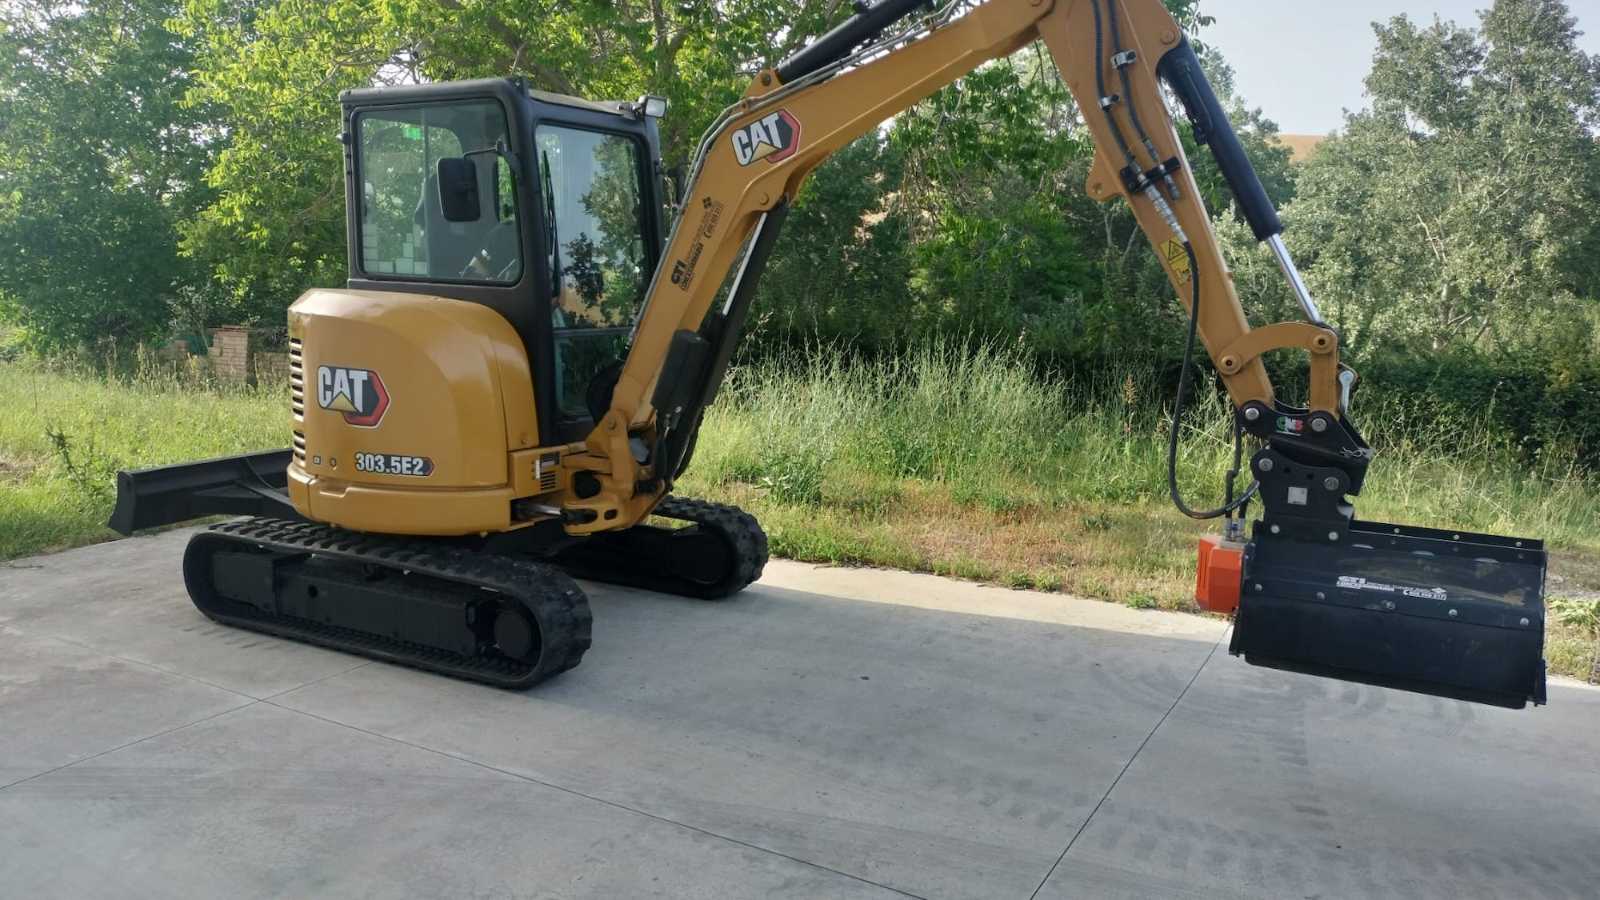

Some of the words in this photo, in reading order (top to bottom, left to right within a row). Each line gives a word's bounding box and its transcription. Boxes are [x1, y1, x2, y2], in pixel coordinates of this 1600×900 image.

[731, 112, 783, 165] CAT
[317, 366, 368, 413] CAT
[355, 453, 425, 476] 303.5E2
